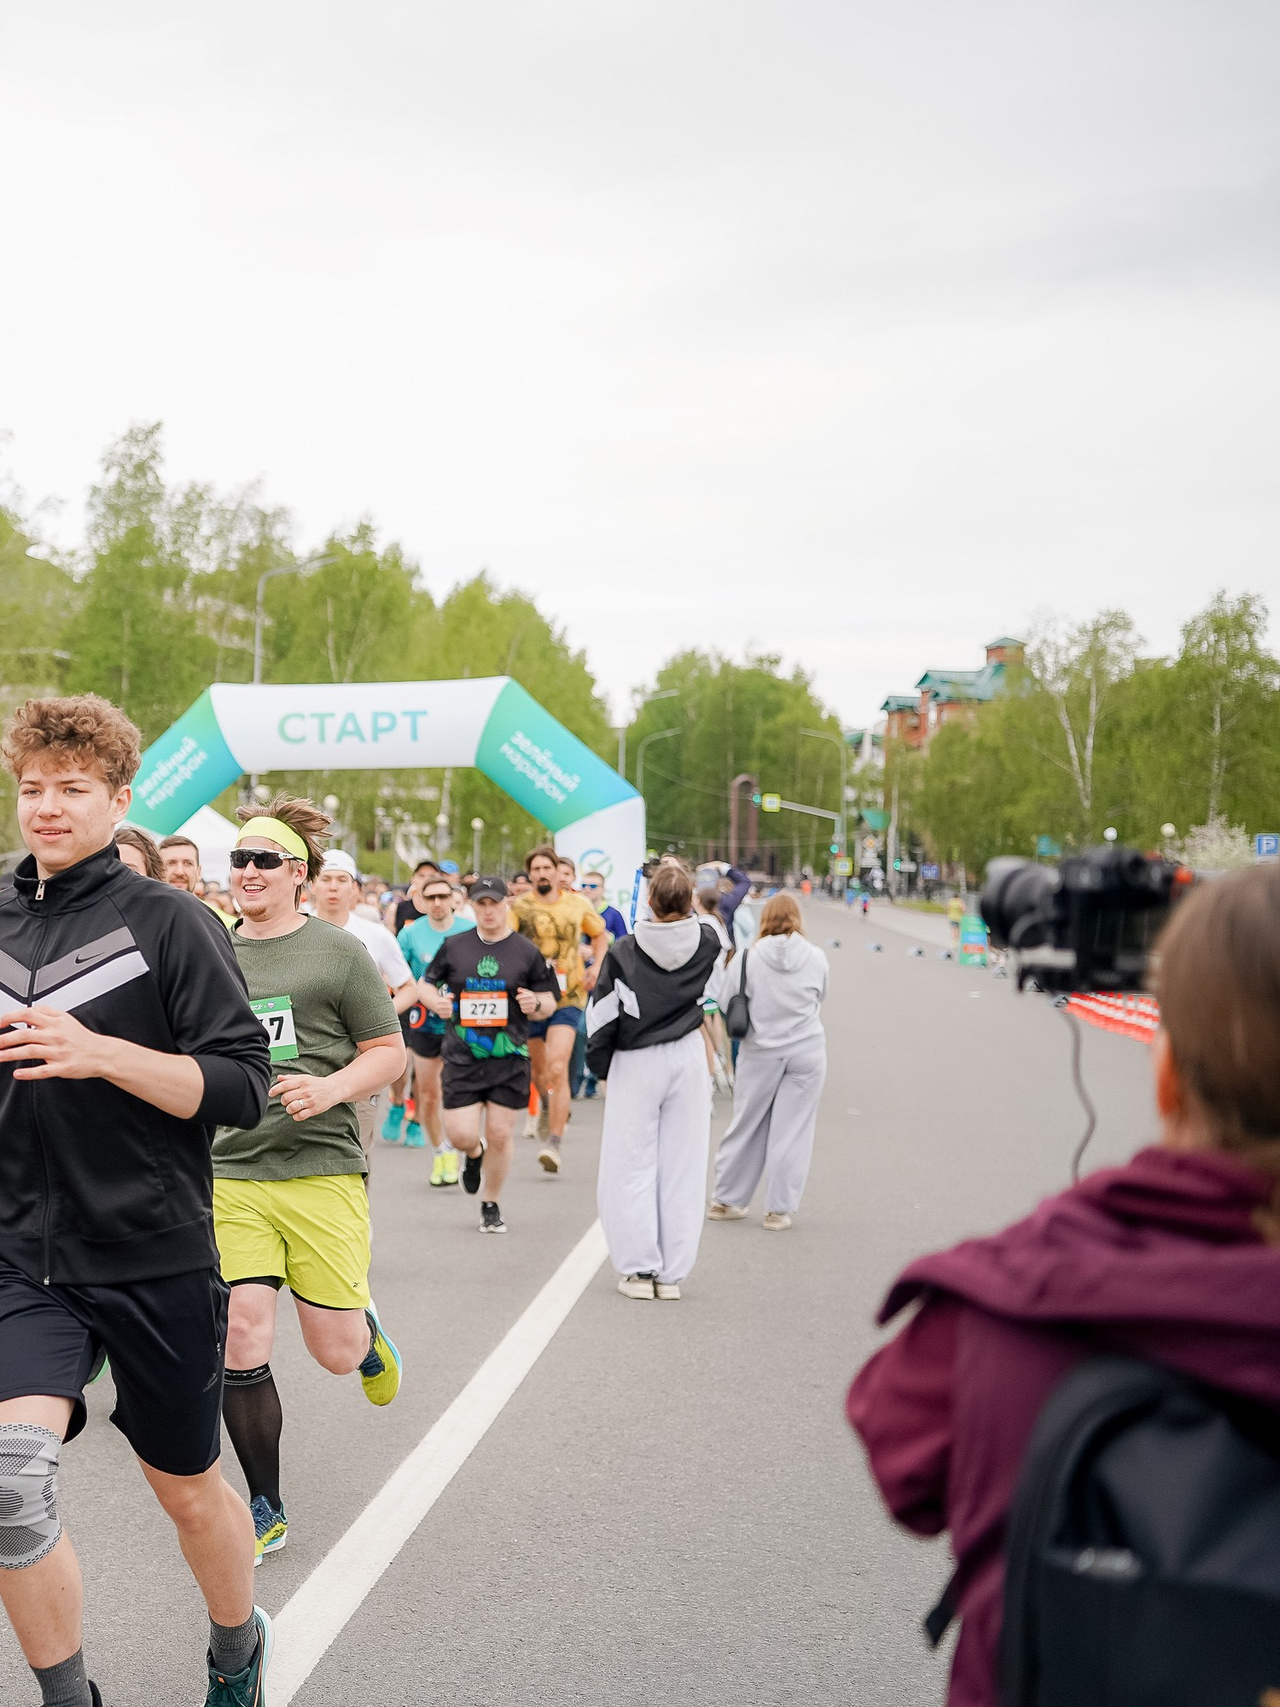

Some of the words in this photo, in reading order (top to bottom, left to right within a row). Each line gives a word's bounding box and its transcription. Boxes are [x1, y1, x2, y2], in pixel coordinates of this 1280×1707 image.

[277, 710, 428, 744] СТАРТ
[1262, 836, 1276, 853] P
[470, 1003, 497, 1015] 272
[260, 1016, 284, 1041] 7
